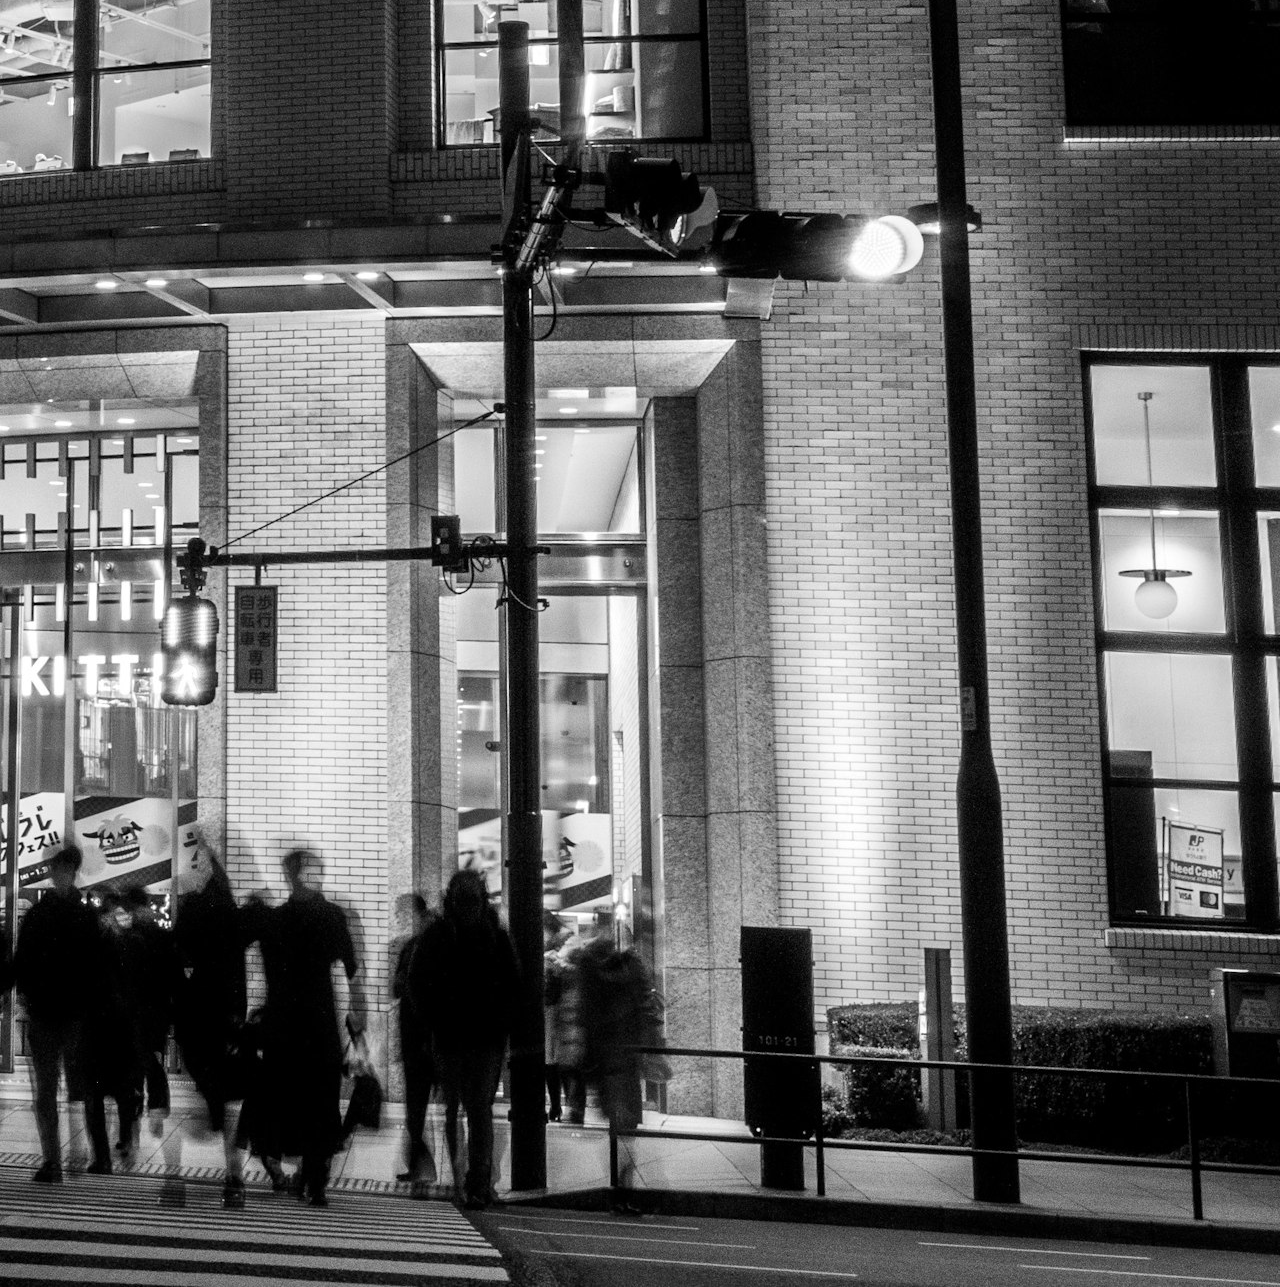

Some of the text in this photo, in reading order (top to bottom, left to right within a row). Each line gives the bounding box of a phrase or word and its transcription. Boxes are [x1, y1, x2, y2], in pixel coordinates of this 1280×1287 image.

[239, 594, 255, 646] 自転車
[258, 594, 273, 648] 歩行者
[248, 649, 264, 685] 専用
[1170, 861, 1195, 876] Need
[1195, 865, 1223, 880] Cash?
[758, 1035, 798, 1047] 101-21
